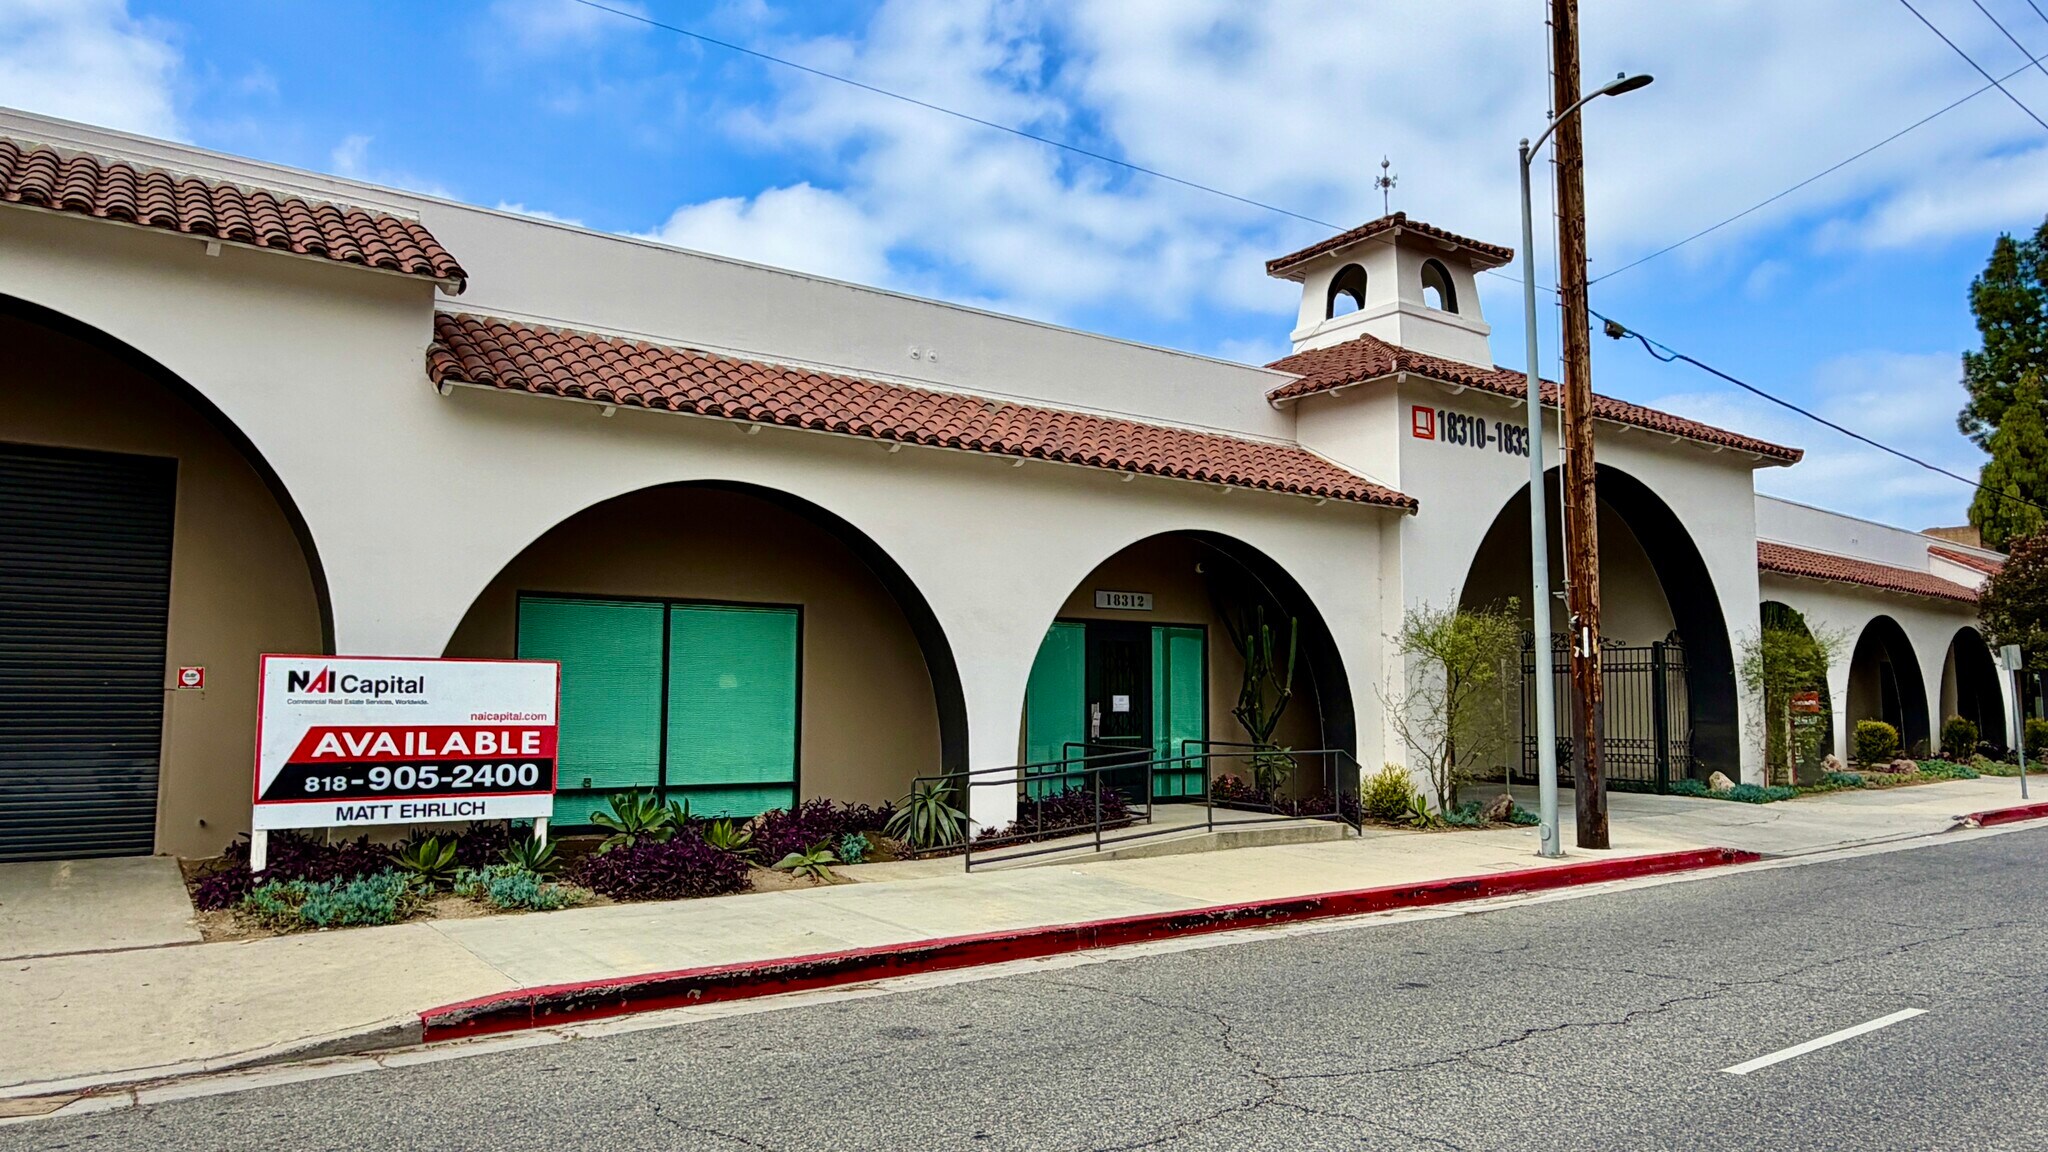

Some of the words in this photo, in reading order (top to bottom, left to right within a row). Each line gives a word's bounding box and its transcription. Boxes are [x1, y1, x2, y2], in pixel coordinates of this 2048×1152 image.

[1437, 410, 1530, 458] 18310-1833
[1106, 594, 1144, 607] 18312
[287, 665, 336, 694] NAI
[340, 674, 424, 698] Capital
[470, 711, 547, 722] naicapital.com
[310, 730, 541, 758] AVAILABLE
[335, 805, 393, 821] MATT
[400, 801, 486, 818] EHRLICH
